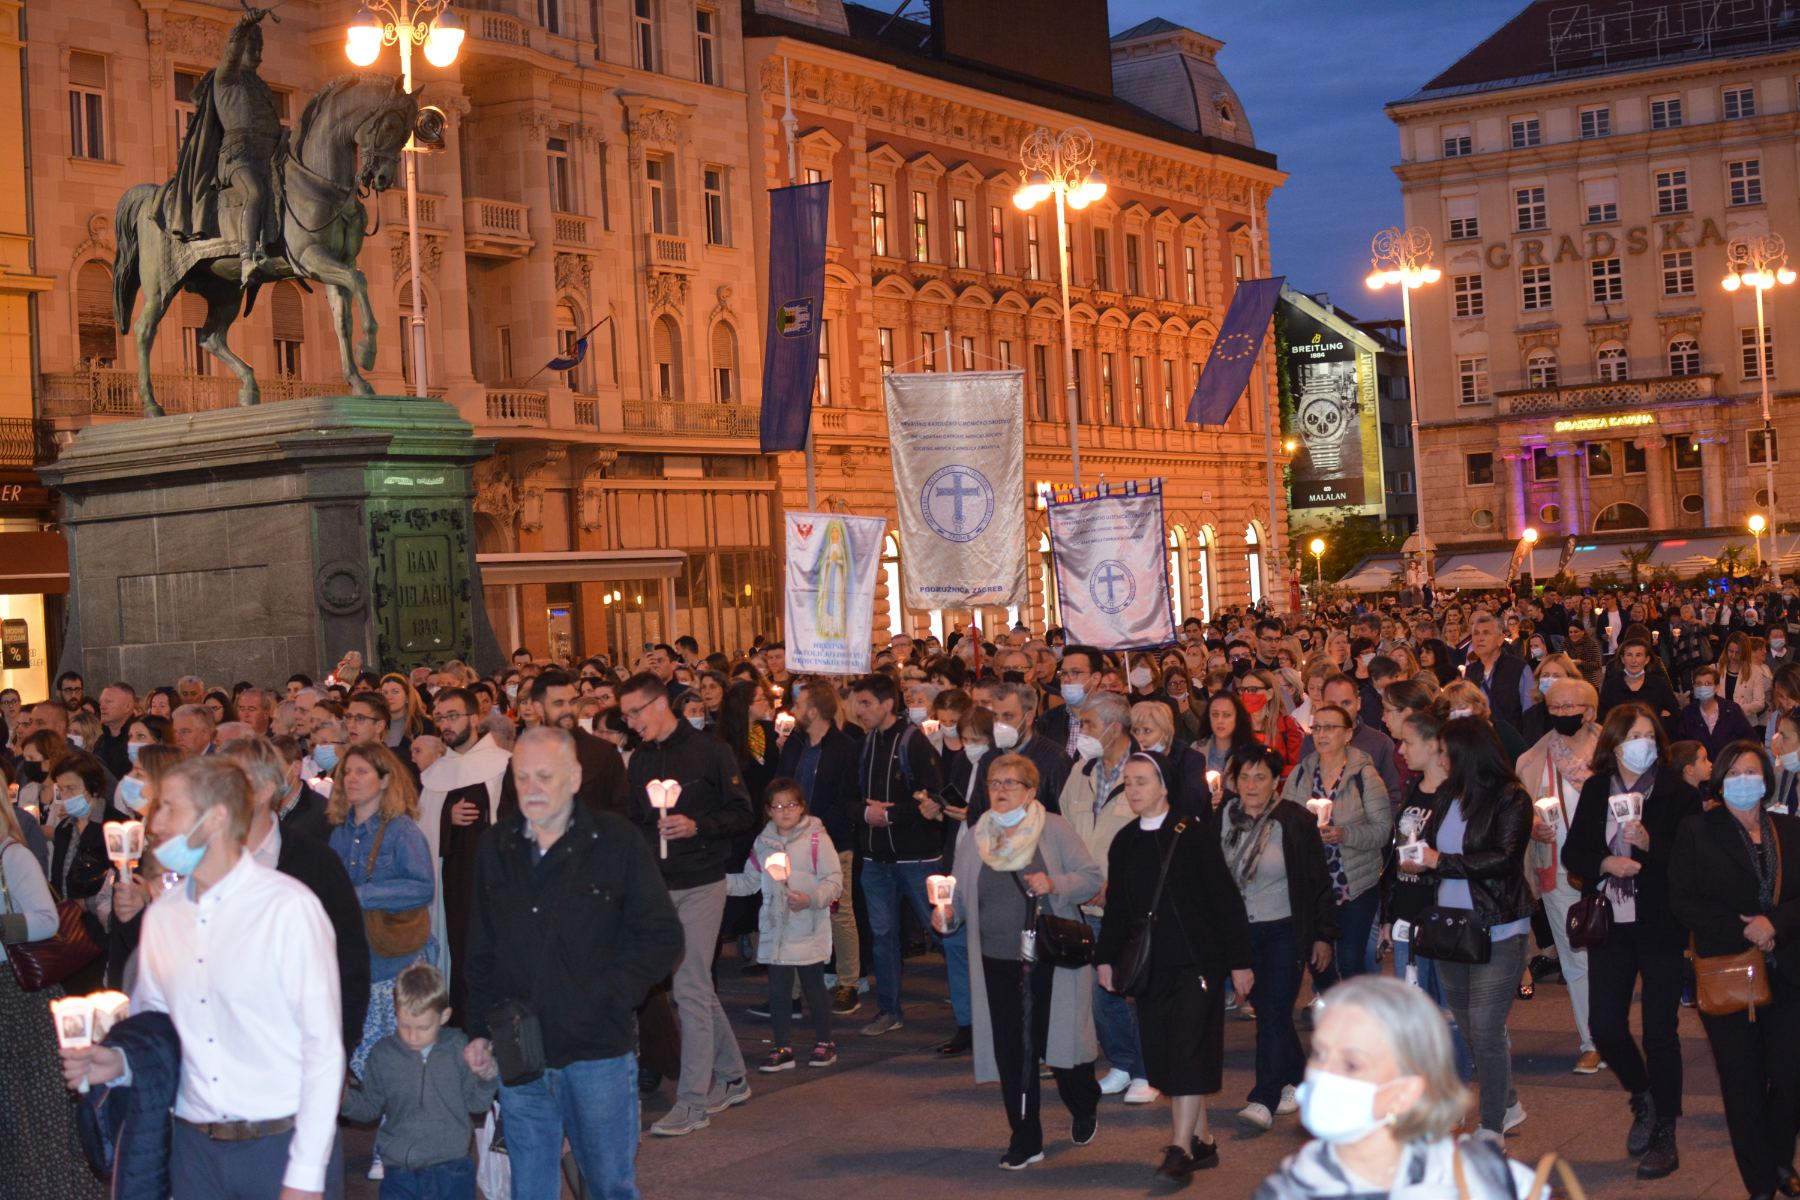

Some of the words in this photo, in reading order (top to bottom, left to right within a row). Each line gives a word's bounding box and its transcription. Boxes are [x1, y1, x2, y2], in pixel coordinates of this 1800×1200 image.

[1484, 217, 1727, 271] GRADSKA
[1291, 342, 1344, 354] BREITLING
[1361, 353, 1375, 415] CHRONOMAT
[1309, 492, 1347, 502] MALALAN
[407, 550, 438, 573] BAN
[920, 586, 969, 594] PODRUŽNICA
[972, 585, 1003, 594] ZAGREB
[10, 647, 21, 662] %
